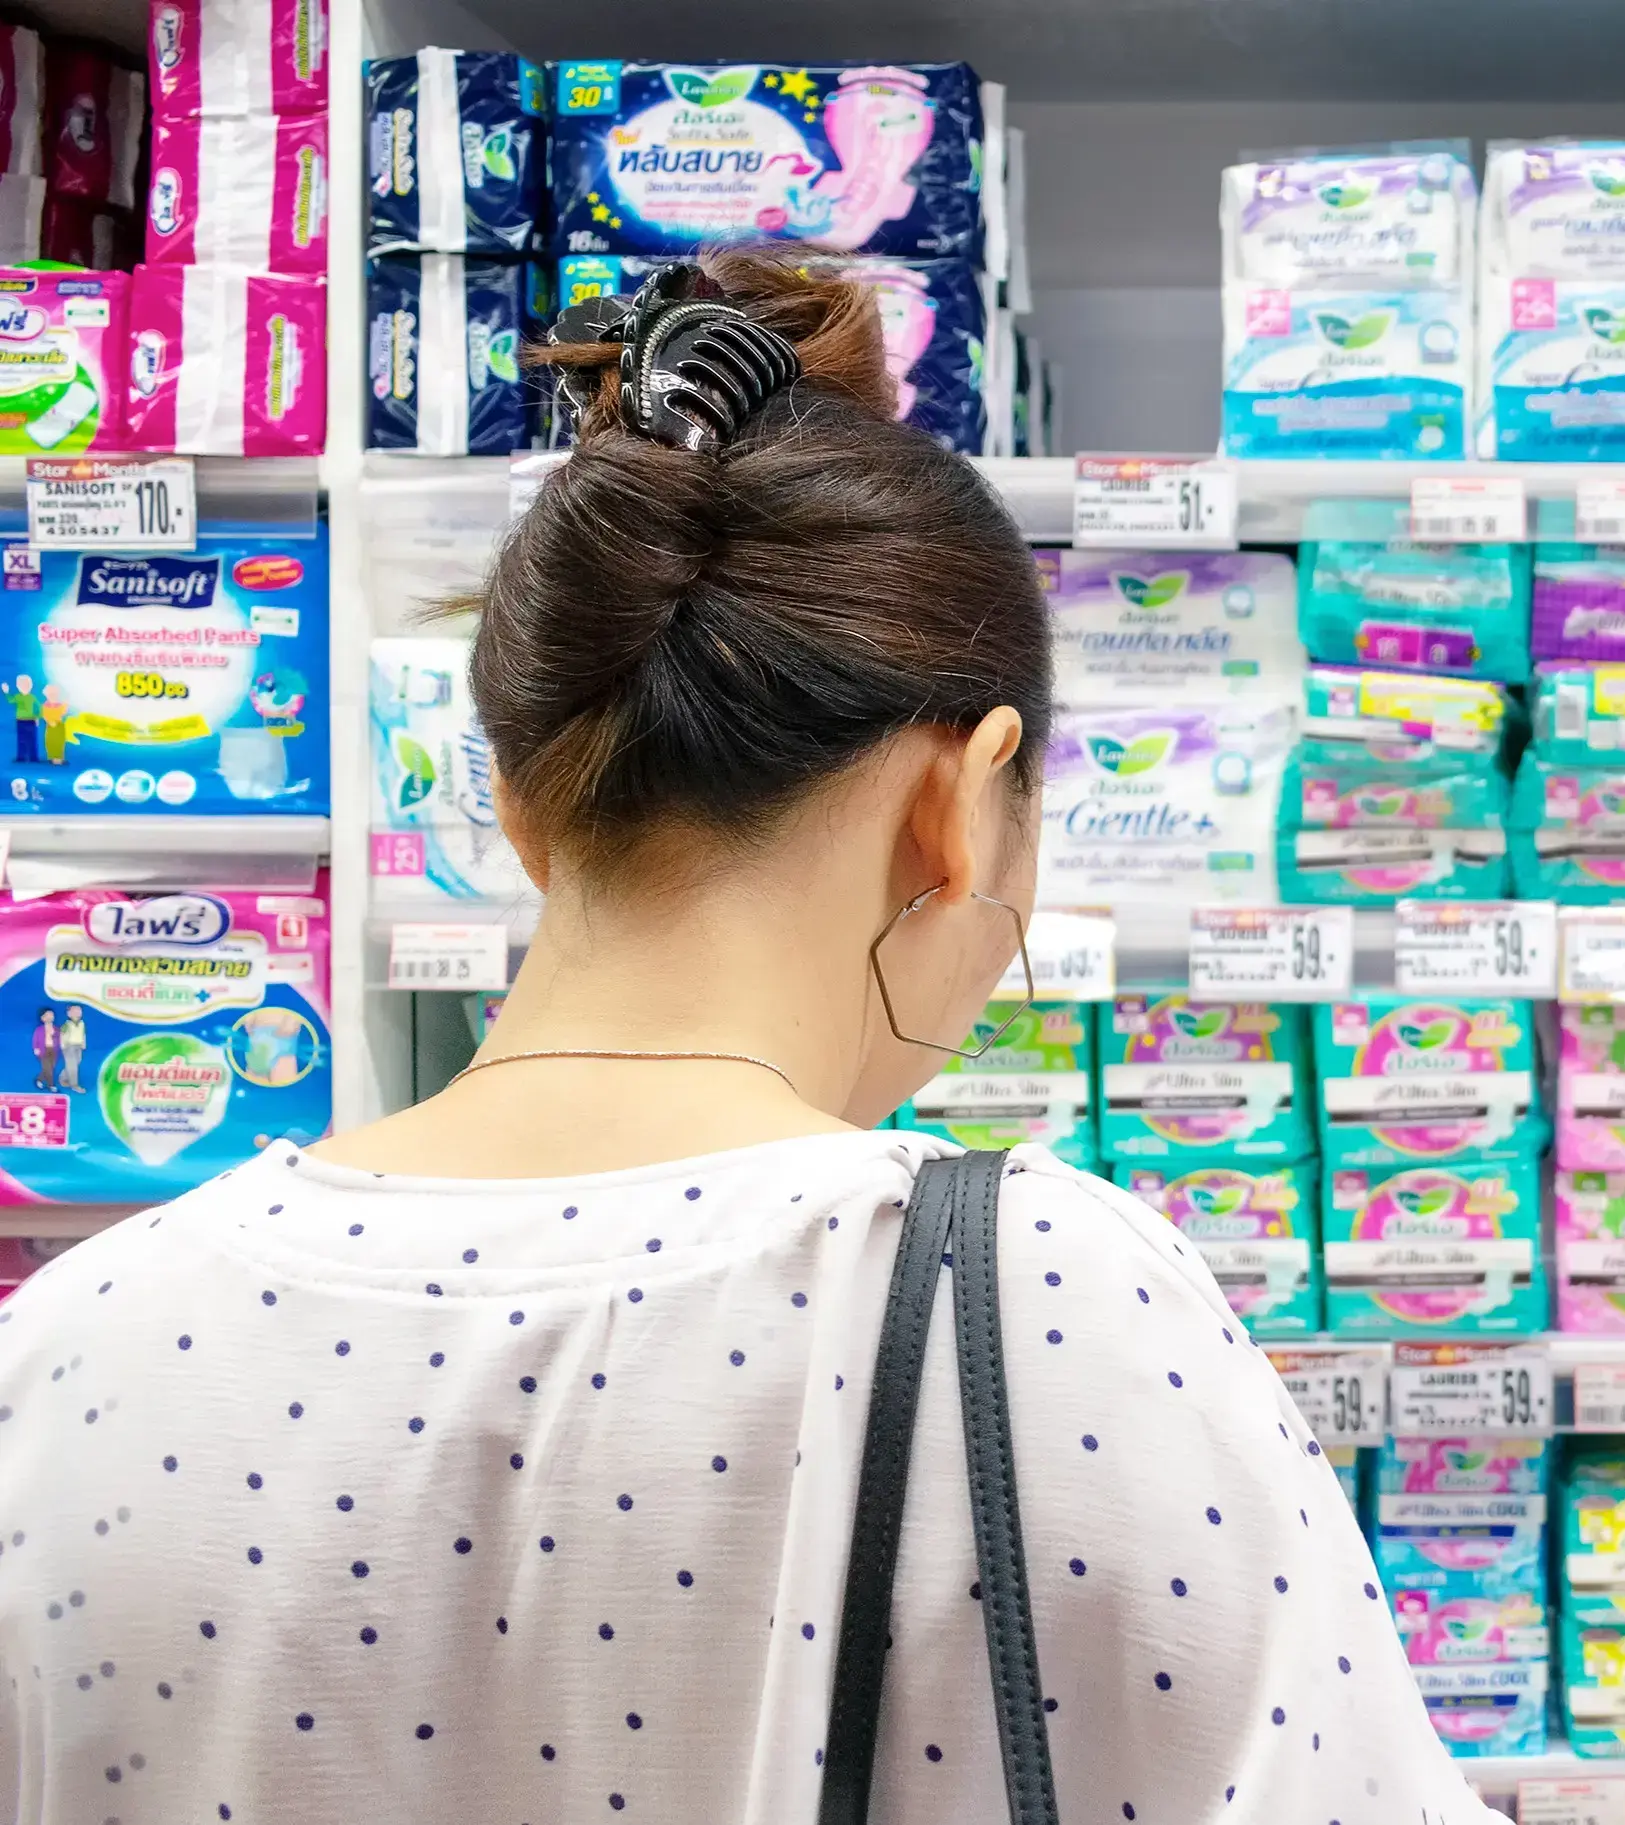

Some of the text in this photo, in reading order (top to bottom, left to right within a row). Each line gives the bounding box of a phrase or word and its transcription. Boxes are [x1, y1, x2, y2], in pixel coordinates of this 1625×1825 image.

[568, 87, 601, 108] 30
[618, 144, 763, 174] หลับสบาย
[32, 463, 71, 478] Star
[46, 482, 115, 496] SANISOFT
[9, 553, 35, 570] XL
[88, 566, 208, 604] Sanisoft
[39, 624, 103, 645] Super
[116, 672, 164, 698] 850
[1420, 1372, 1478, 1386] LAURIER
[1502, 1370, 1530, 1424] 59
